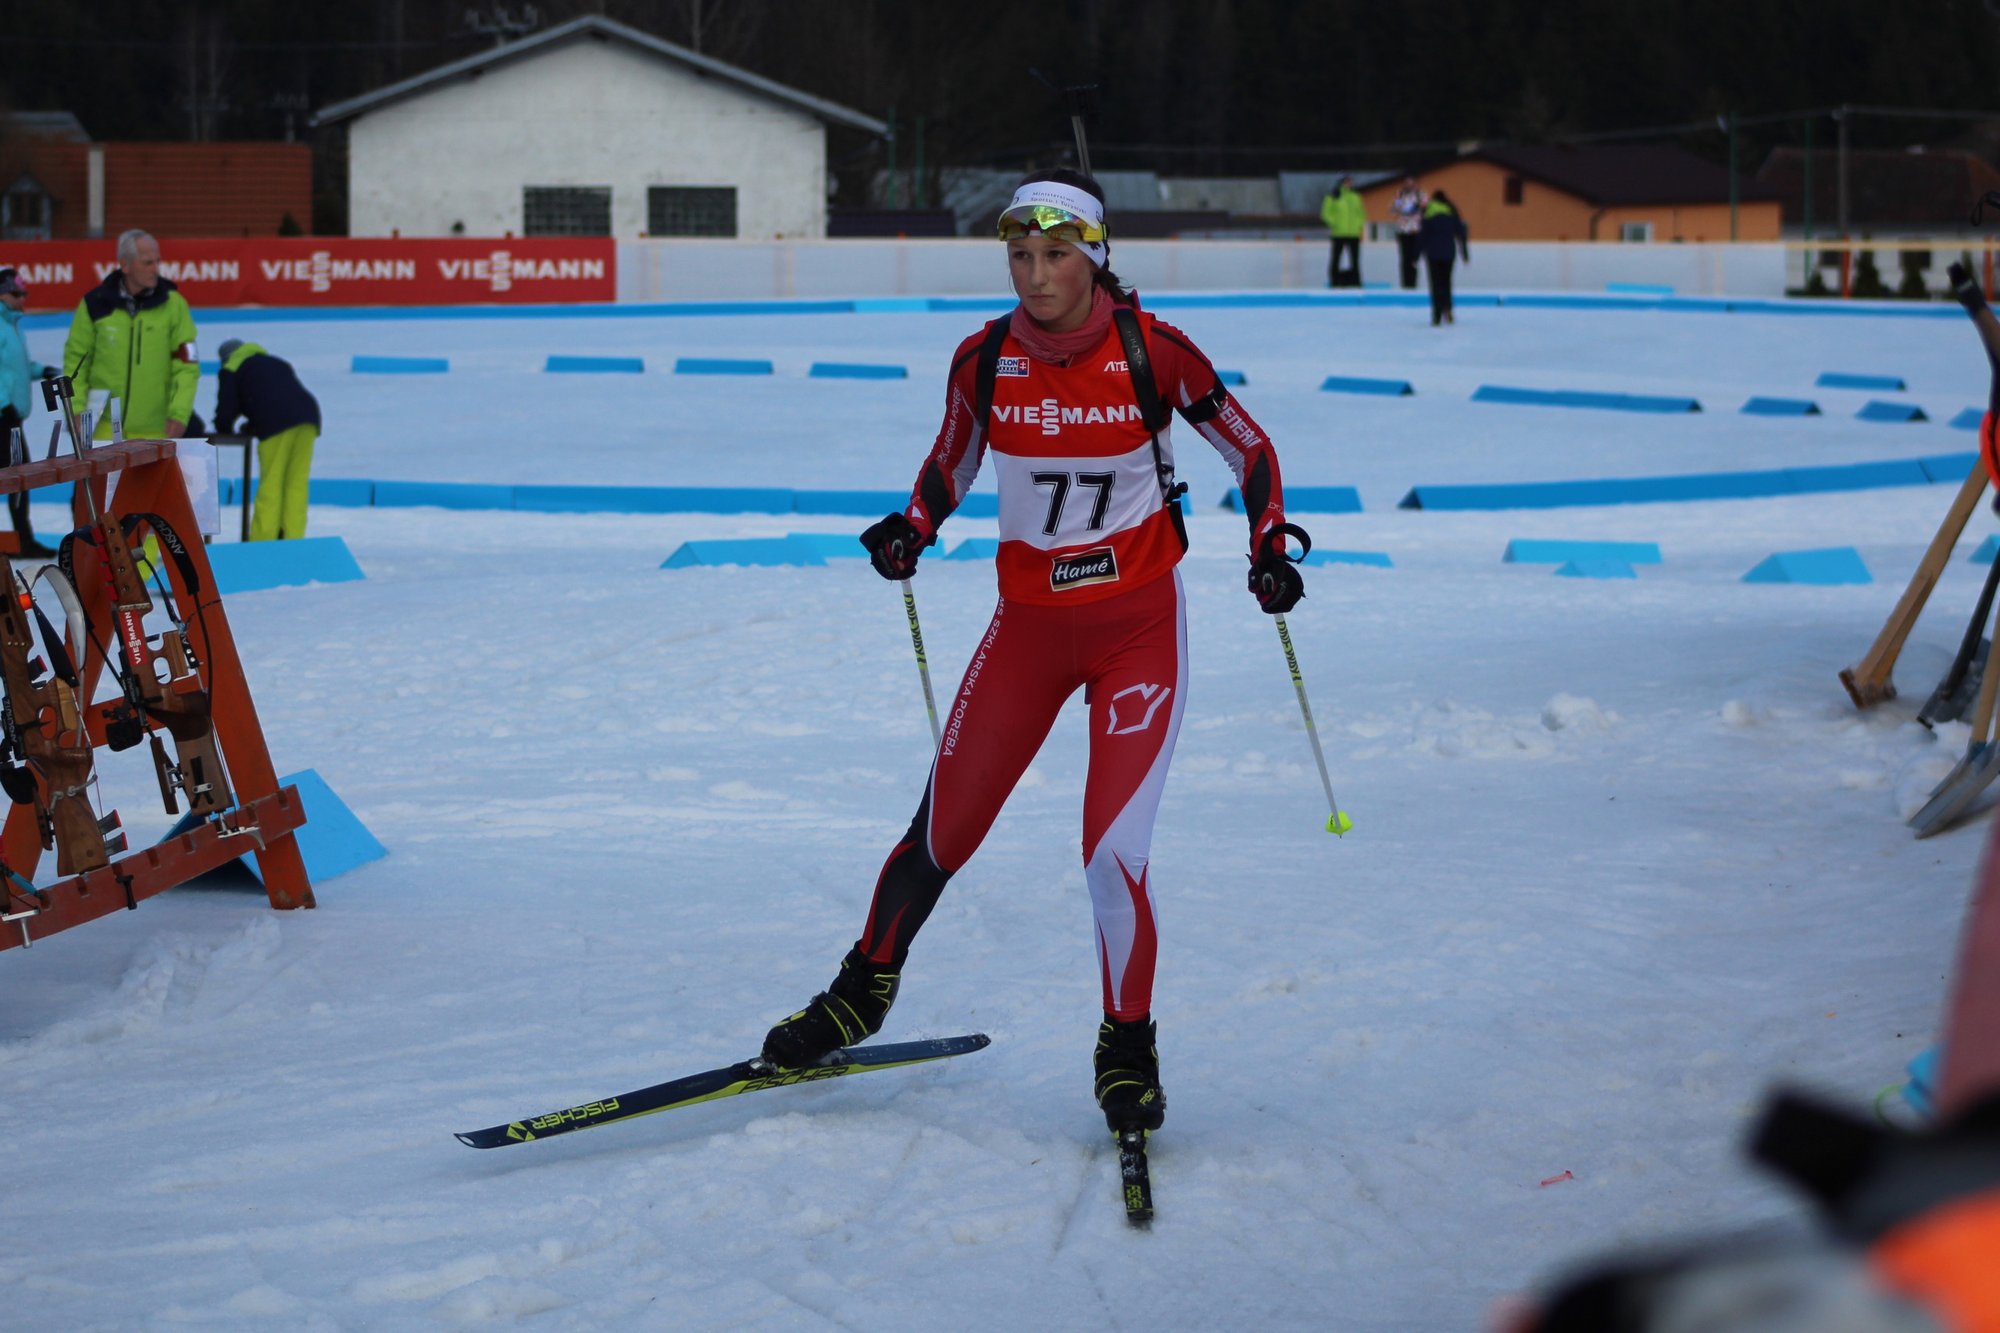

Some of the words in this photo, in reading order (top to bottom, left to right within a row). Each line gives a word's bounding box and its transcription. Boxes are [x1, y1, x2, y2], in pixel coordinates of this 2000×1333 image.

[1030, 470, 1116, 537] 77
[1055, 558, 1108, 581] Hamé
[962, 618, 1001, 697] SZKLARSKA
[738, 1065, 850, 1095] FISCHER
[528, 1097, 620, 1131] FISCHER
